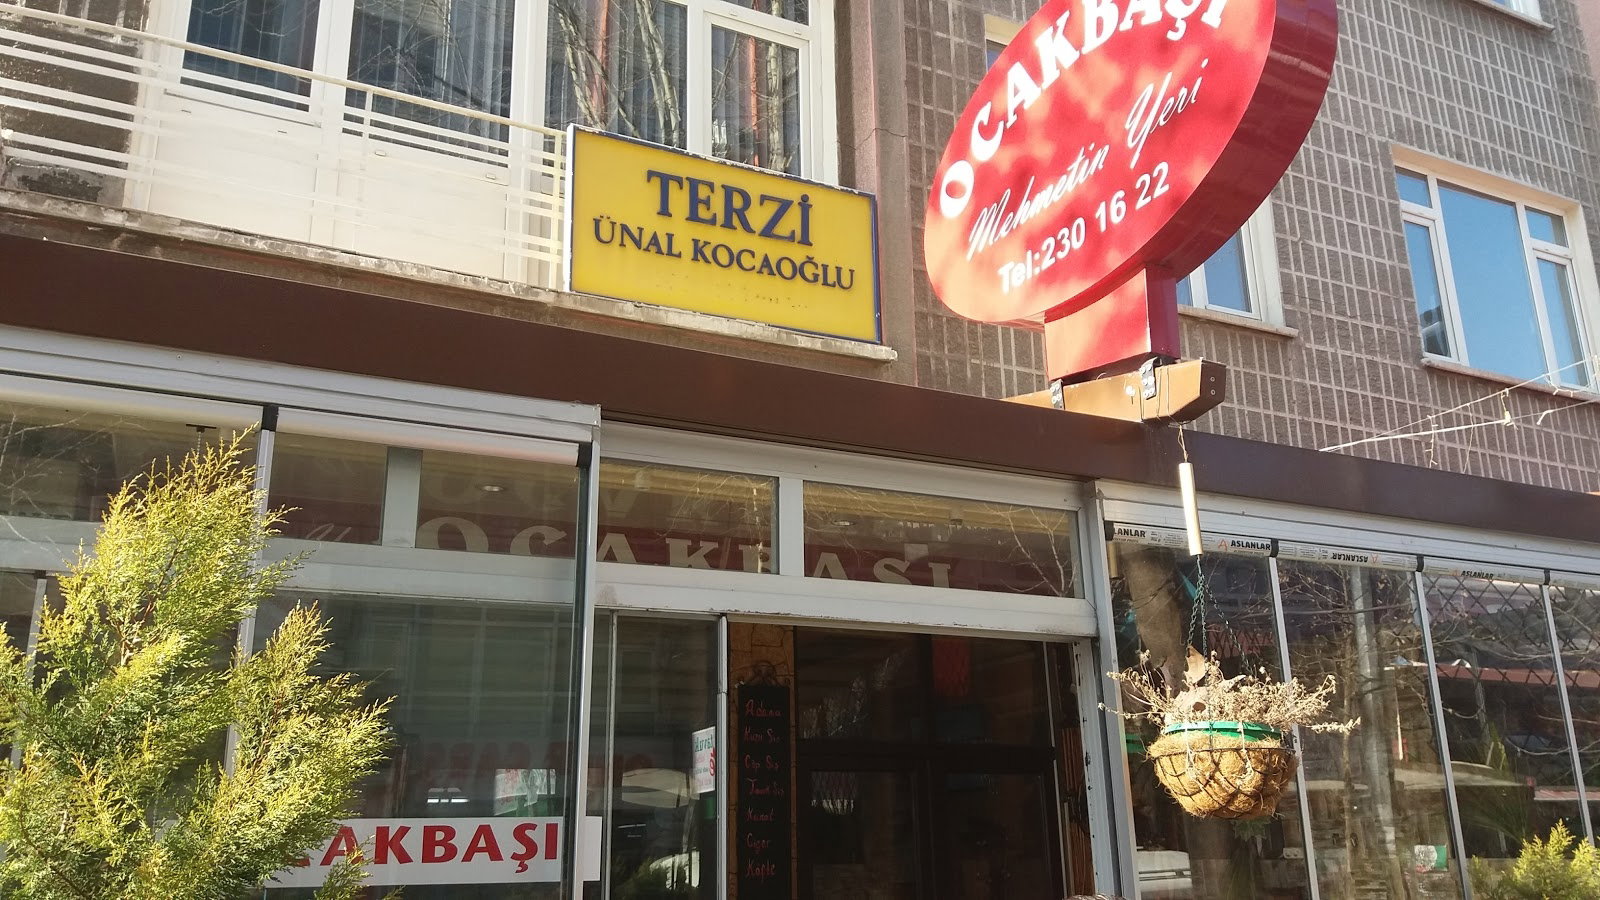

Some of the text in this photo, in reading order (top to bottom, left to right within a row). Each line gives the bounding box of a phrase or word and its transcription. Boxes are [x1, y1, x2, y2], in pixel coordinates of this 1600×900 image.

[966, 58, 1209, 261] Mehmetin Yeri
[646, 169, 814, 246] TERZİ
[998, 162, 1170, 295] Tel:230 16 22
[592, 214, 855, 290] ÜNAL KOCAOĞLU
[1113, 527, 1147, 538] ANLAR
[1230, 539, 1271, 551] ASLANLAR
[288, 822, 560, 874] AKBAŞI
